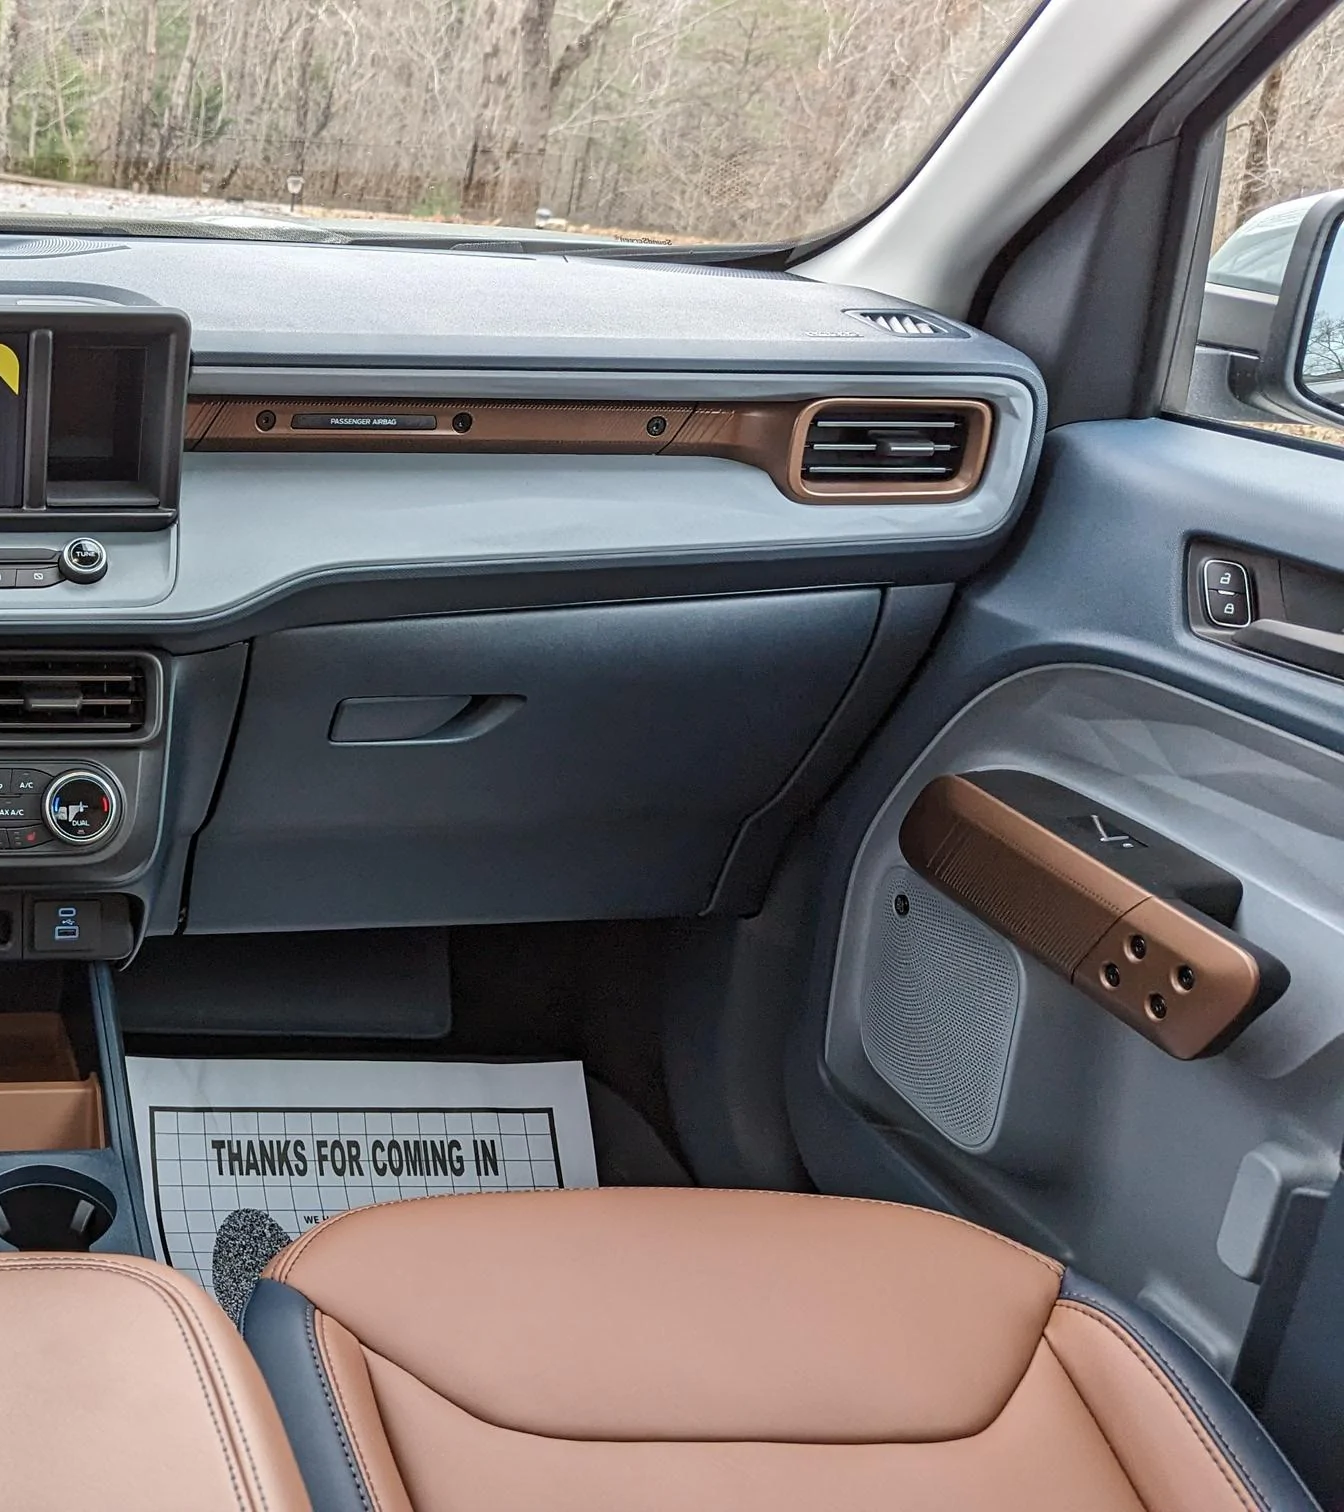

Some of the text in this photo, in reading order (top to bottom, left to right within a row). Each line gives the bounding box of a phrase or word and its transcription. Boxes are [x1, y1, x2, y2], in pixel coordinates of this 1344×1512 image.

[211, 1139, 499, 1176] THANKS FOR COMING IN
[304, 1216, 319, 1224] WE
